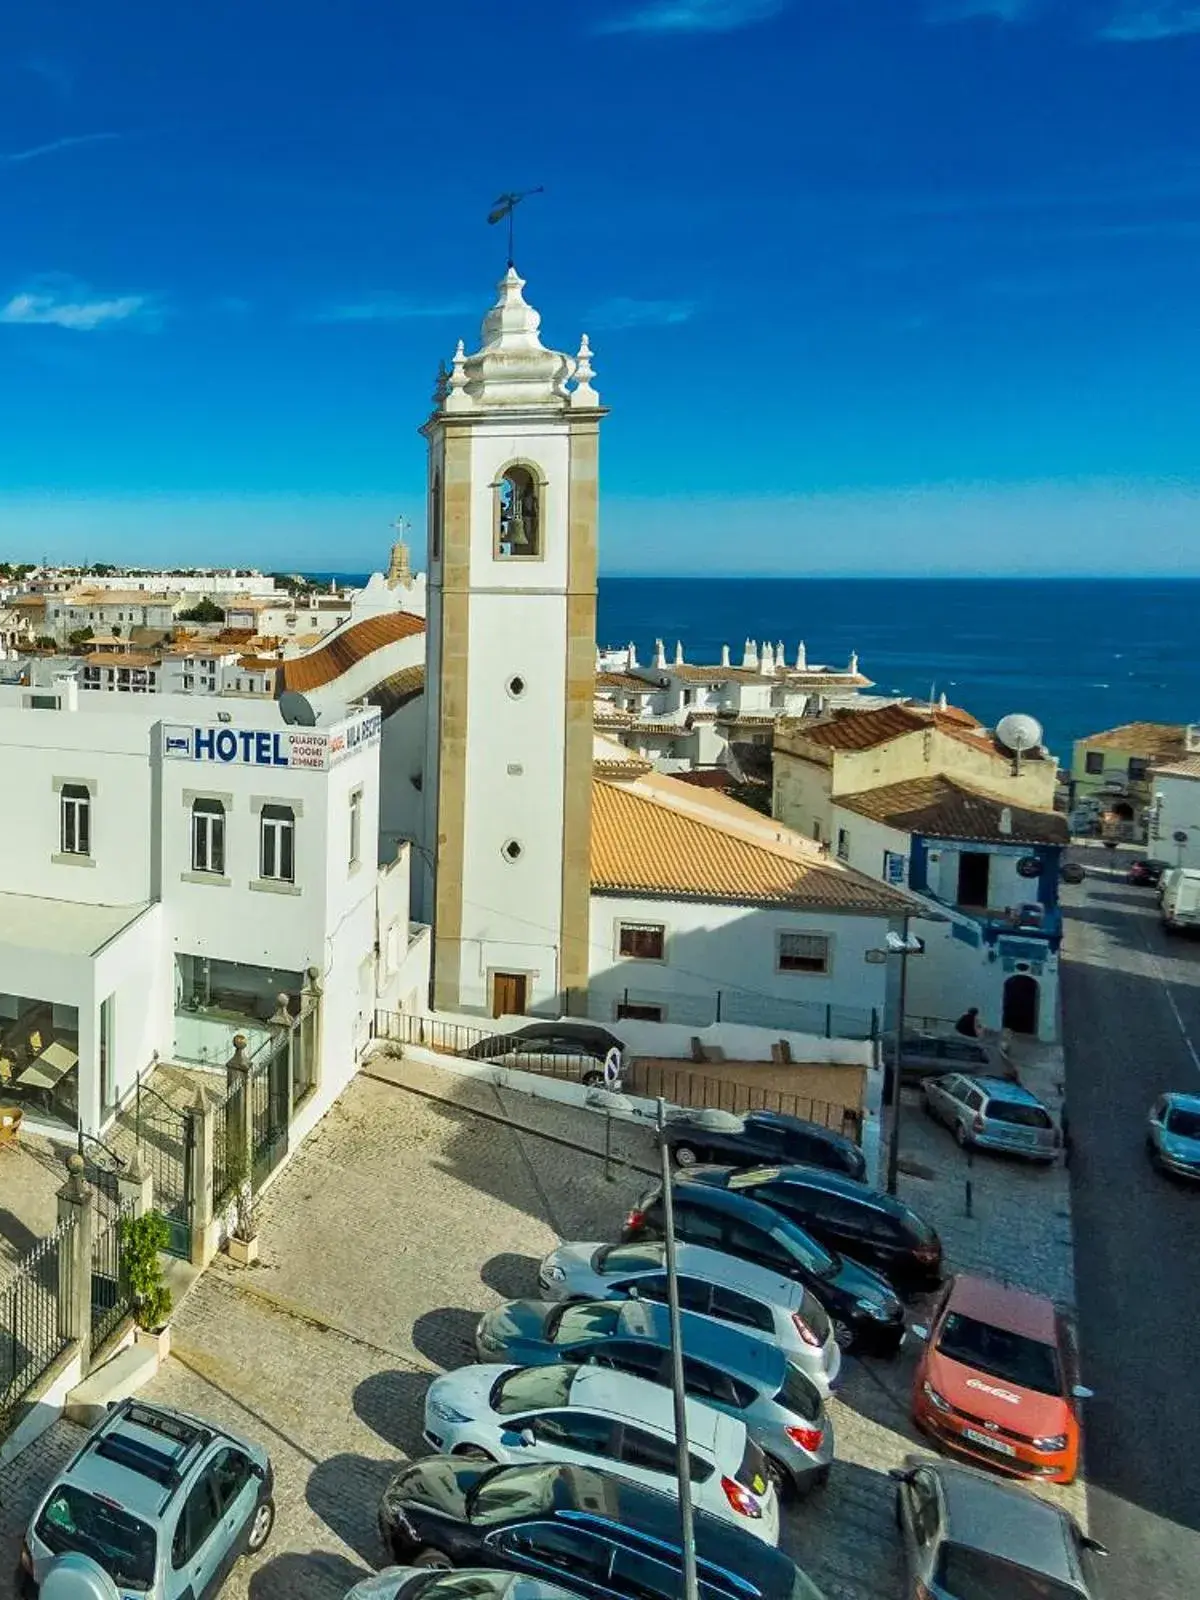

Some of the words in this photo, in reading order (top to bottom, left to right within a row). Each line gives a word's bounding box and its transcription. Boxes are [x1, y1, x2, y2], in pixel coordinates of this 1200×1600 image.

[289, 735, 327, 746] QUARTOS
[194, 728, 288, 765] HOTEL
[292, 747, 323, 757] ROOMS
[292, 757, 324, 768] ZIMMER
